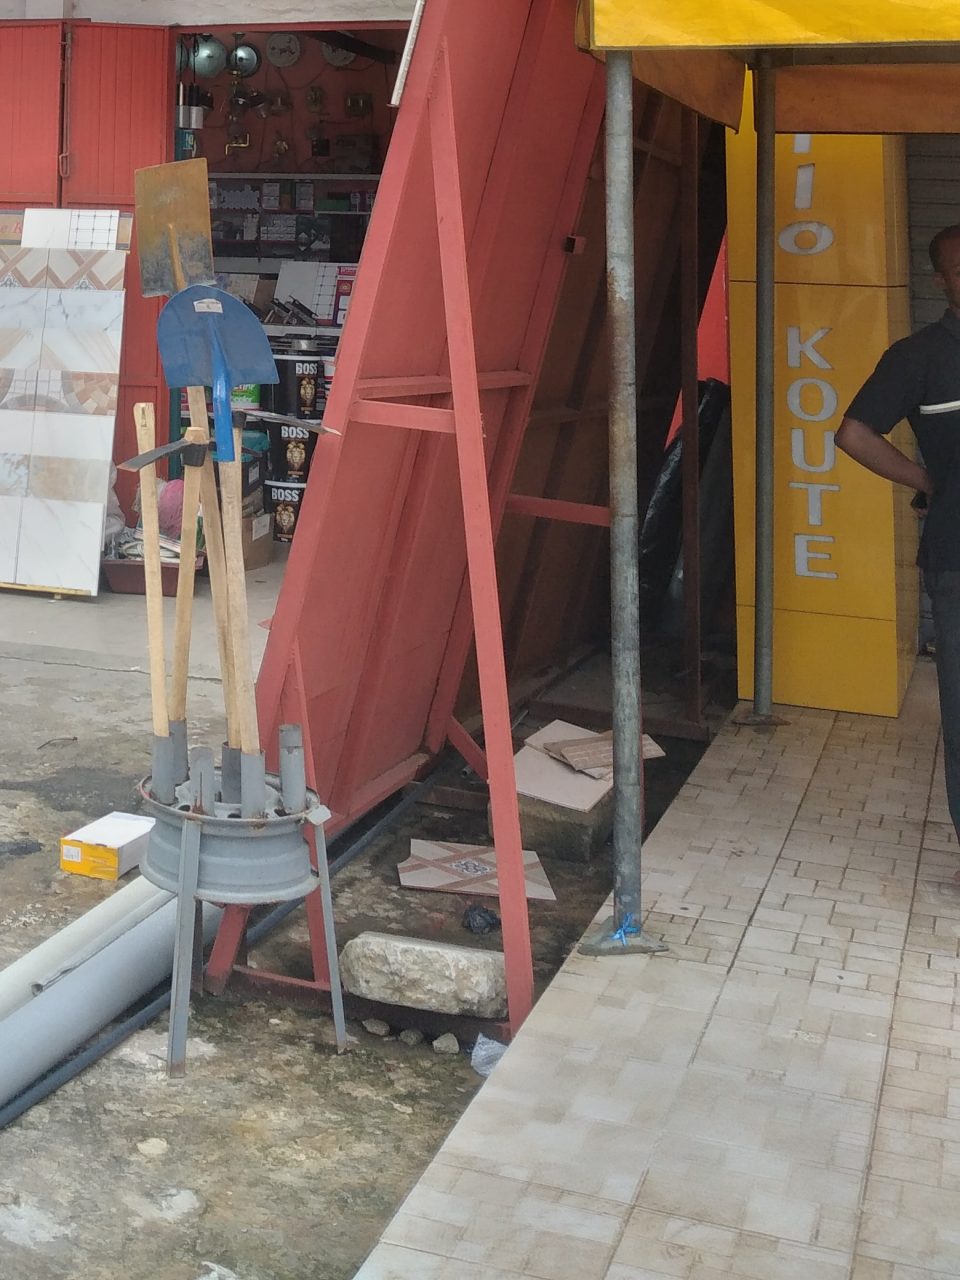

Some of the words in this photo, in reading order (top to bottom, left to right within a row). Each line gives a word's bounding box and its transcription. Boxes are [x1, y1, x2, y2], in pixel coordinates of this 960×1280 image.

[295, 362, 318, 375] BOSS
[281, 425, 309, 439] BOSS
[786, 326, 841, 580] KOUTE
[271, 487, 299, 502] BOSS
